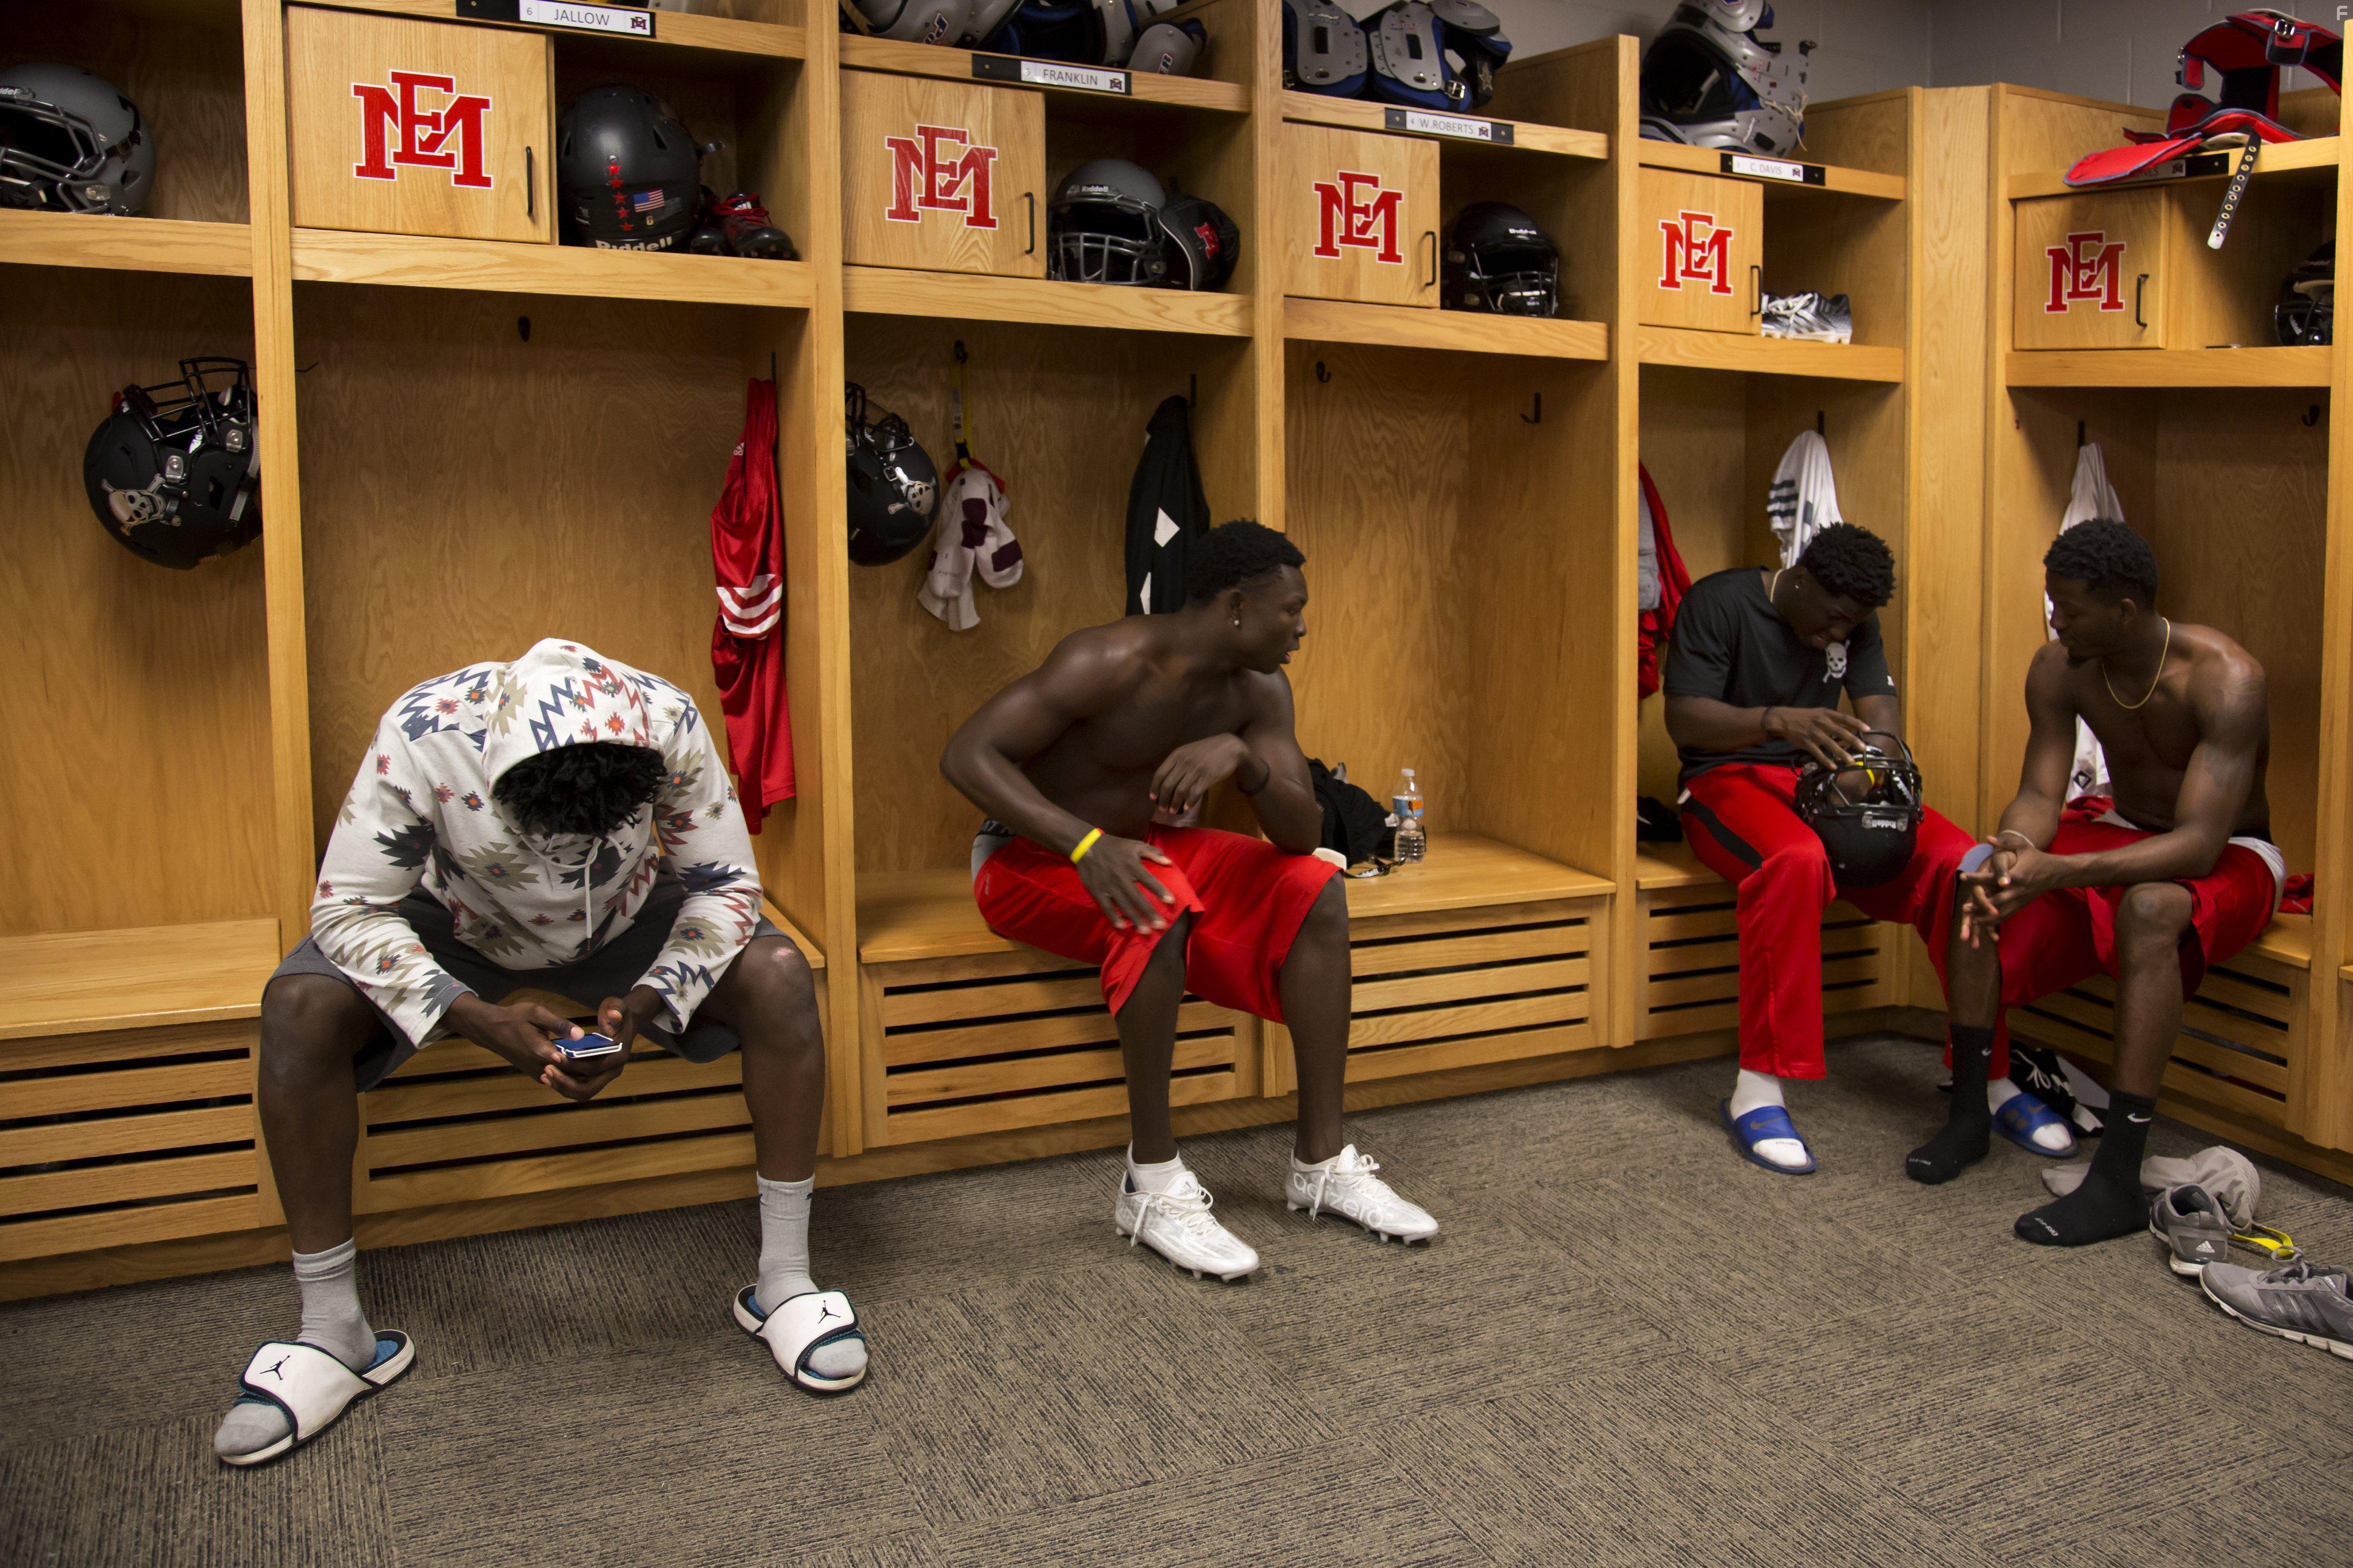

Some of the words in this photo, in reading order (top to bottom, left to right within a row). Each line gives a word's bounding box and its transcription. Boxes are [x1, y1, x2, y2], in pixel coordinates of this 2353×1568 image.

[527, 7, 533, 16] 6
[554, 9, 610, 26] JALLOW
[1043, 69, 1098, 86] FRANKLIN
[1419, 118, 1474, 134] W.ROBERTS
[1760, 164, 1782, 175] DAVIS
